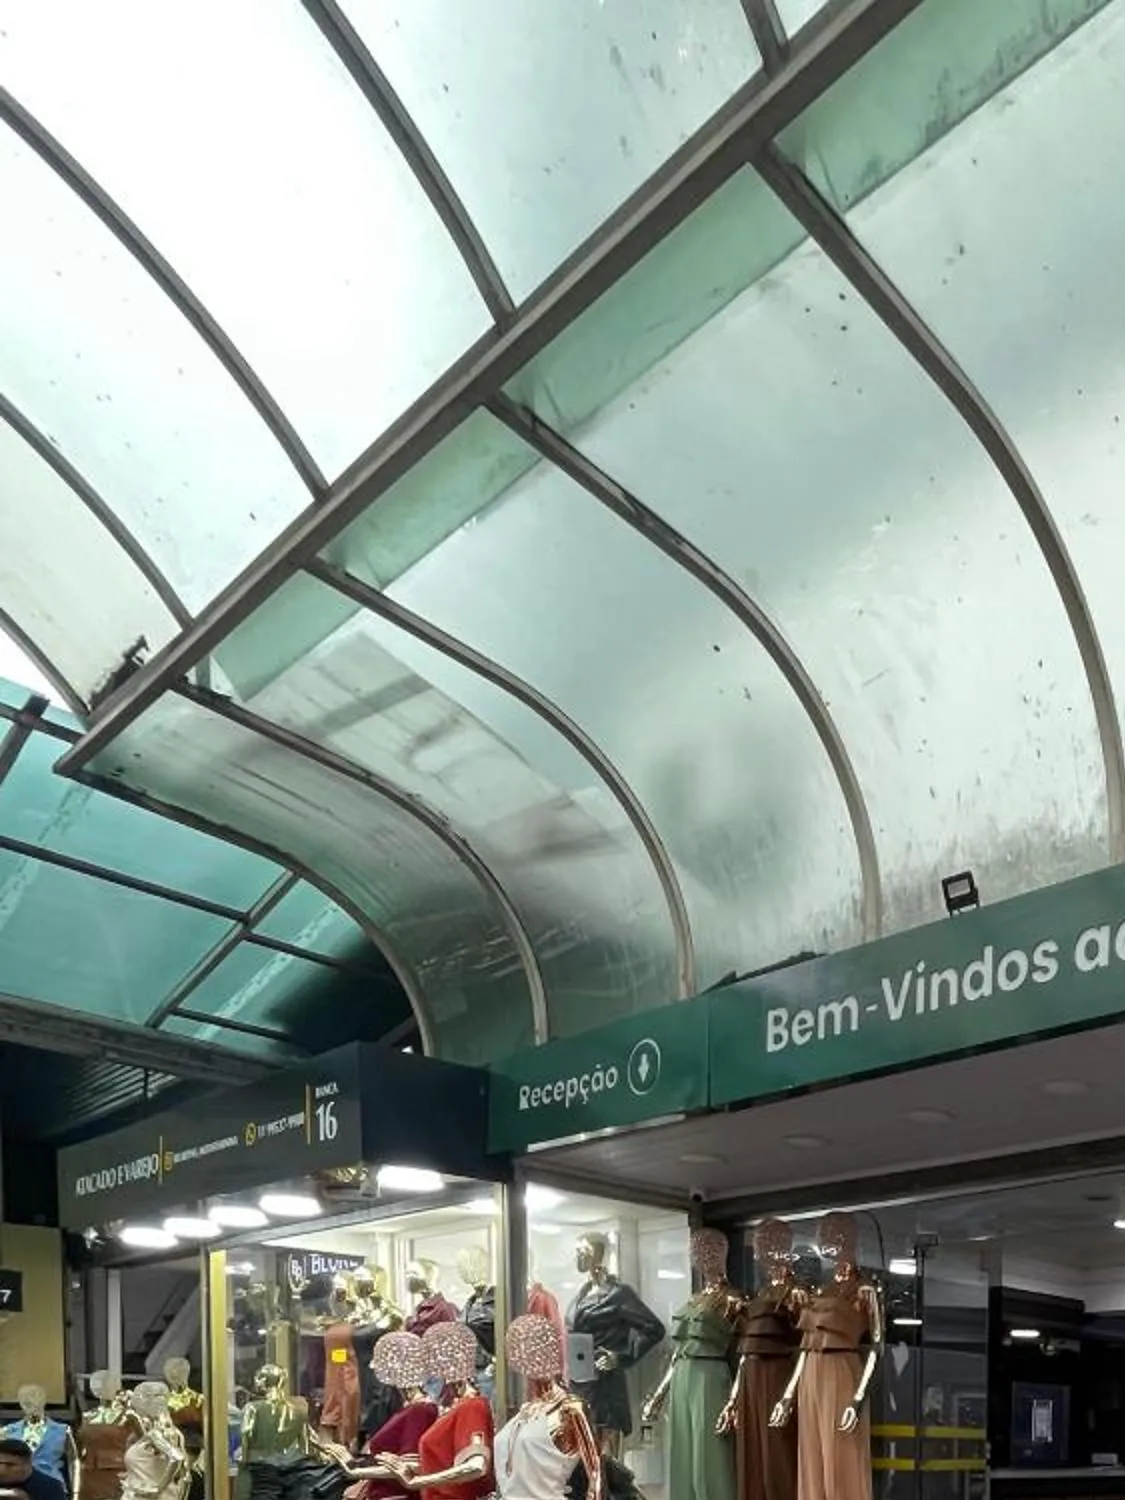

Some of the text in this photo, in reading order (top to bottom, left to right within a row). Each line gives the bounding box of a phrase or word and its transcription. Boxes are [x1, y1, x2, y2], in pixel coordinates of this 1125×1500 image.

[766, 939, 1058, 1055] Bem-Vindos
[518, 1061, 619, 1109] Recepção
[315, 1101, 338, 1141] 16
